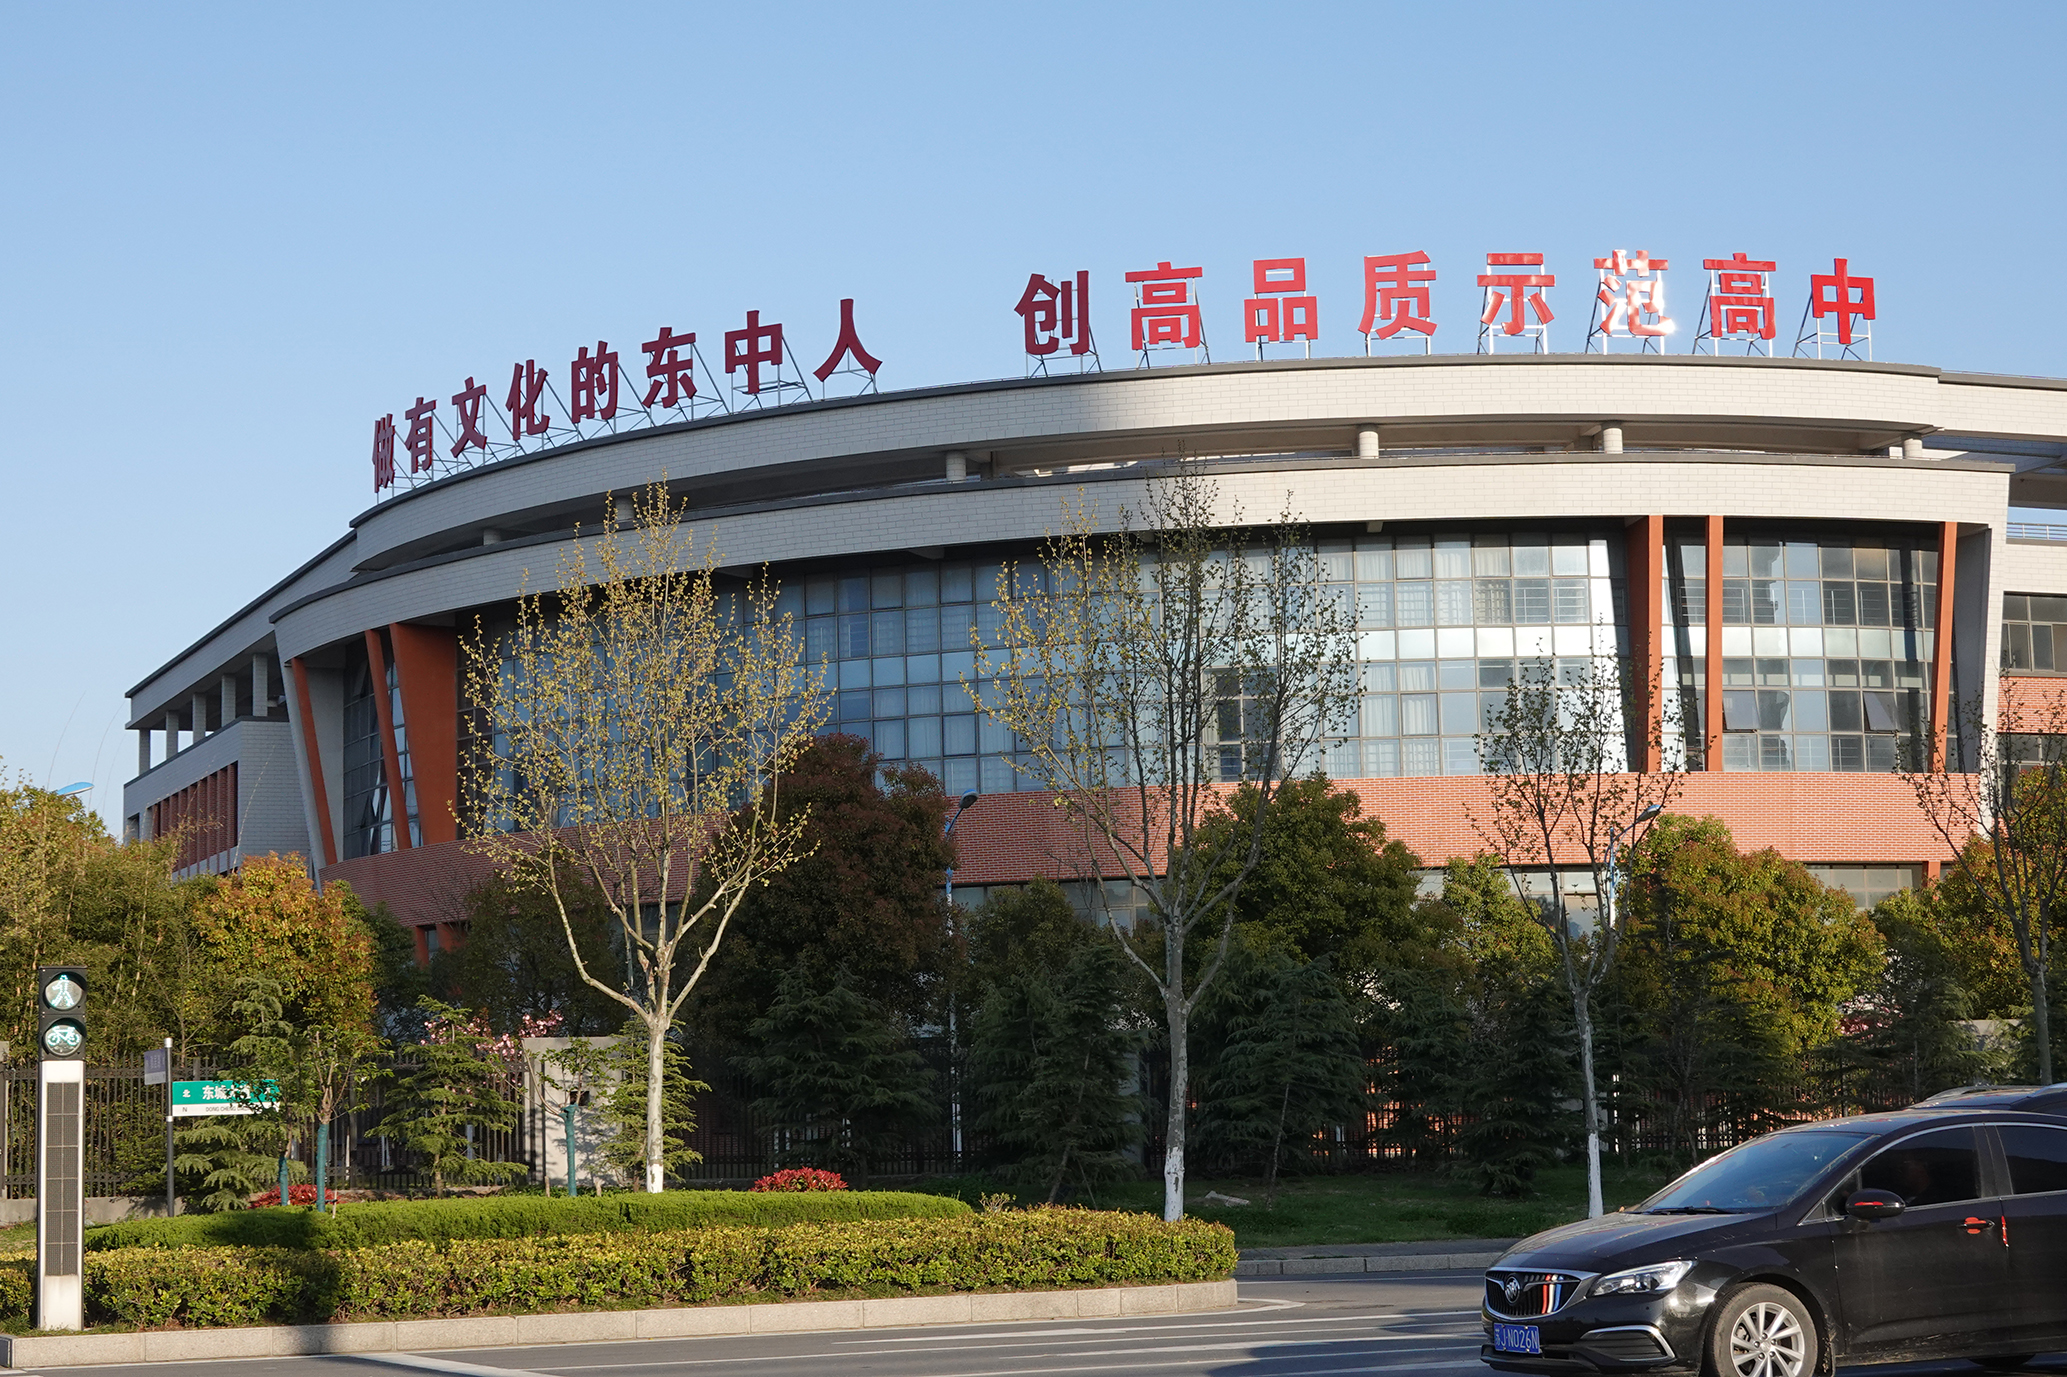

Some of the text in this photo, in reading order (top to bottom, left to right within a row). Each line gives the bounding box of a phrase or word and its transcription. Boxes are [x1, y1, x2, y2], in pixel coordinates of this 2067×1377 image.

[371, 249, 1877, 493] 做有文化的东中人 创高品质示范高中
